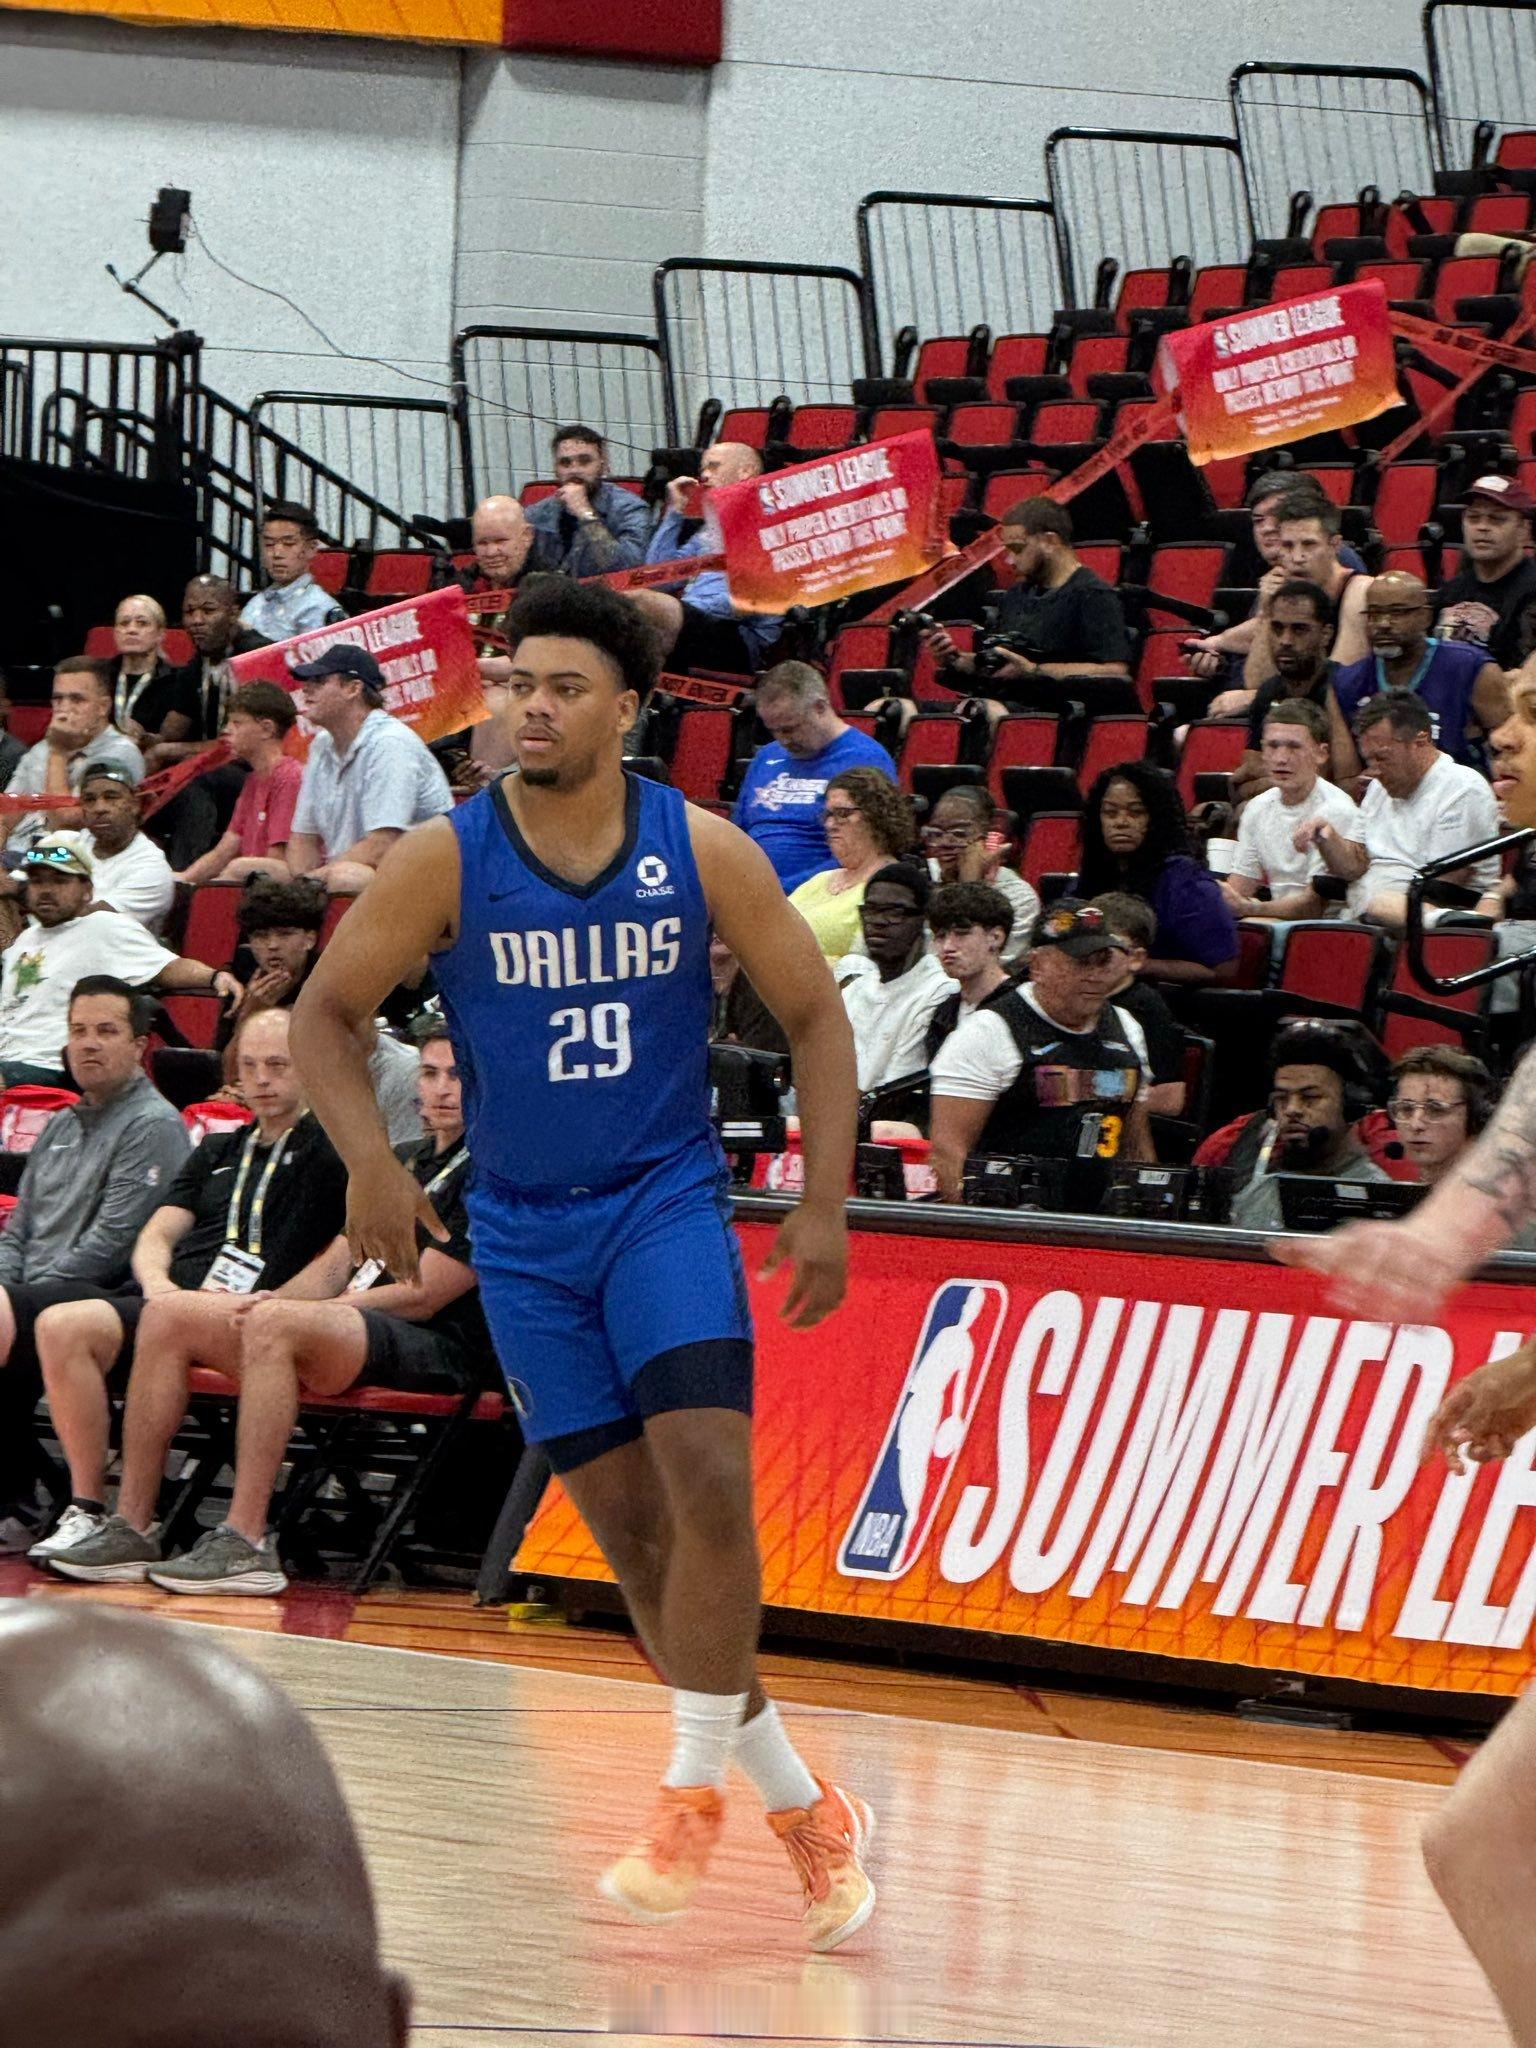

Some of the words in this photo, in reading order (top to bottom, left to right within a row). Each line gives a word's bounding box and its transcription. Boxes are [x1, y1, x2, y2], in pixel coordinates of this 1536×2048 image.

[635, 885, 675, 898] CHASE
[489, 917, 682, 988] DALLAS
[548, 1002, 632, 1082] 29
[941, 1290, 1454, 1632] SUMMER
